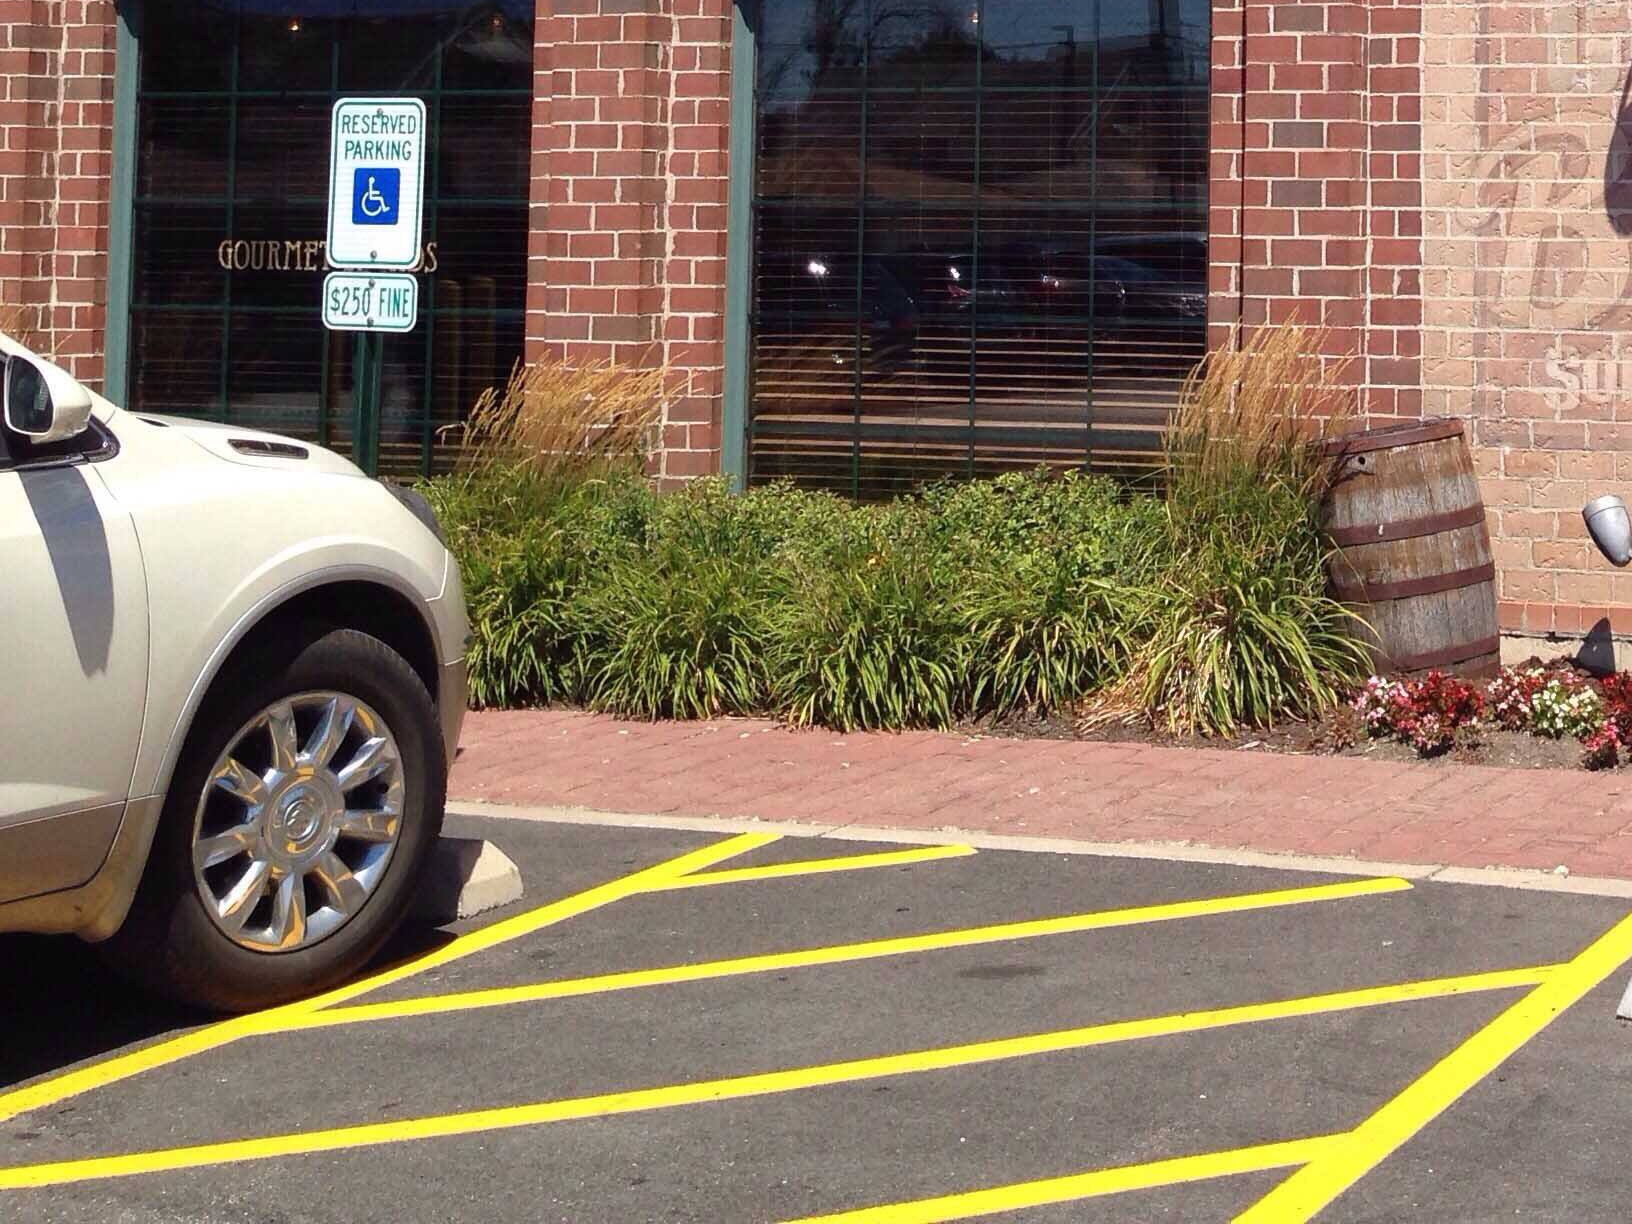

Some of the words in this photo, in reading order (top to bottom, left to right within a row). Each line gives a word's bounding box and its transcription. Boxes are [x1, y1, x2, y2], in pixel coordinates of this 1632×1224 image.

[341, 114, 416, 135] RESERVED
[344, 140, 412, 161] PARKING
[330, 287, 371, 317] $250
[378, 288, 410, 318] FINE
